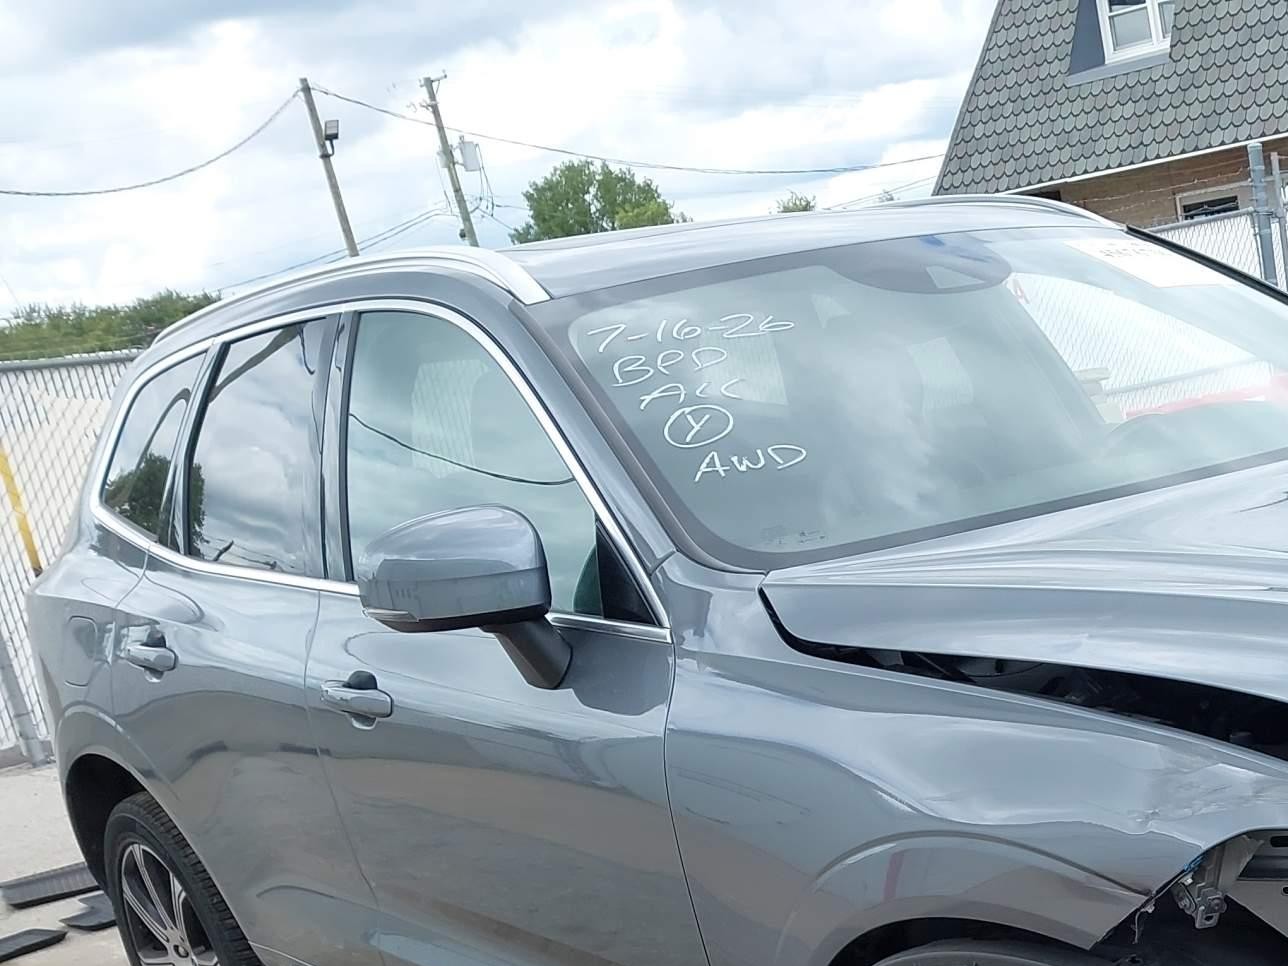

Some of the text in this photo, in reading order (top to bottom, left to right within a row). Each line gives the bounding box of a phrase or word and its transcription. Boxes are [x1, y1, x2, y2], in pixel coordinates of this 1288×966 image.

[587, 313, 795, 353] 7-16-26
[611, 346, 728, 387] BPD
[693, 444, 808, 482] AWD
